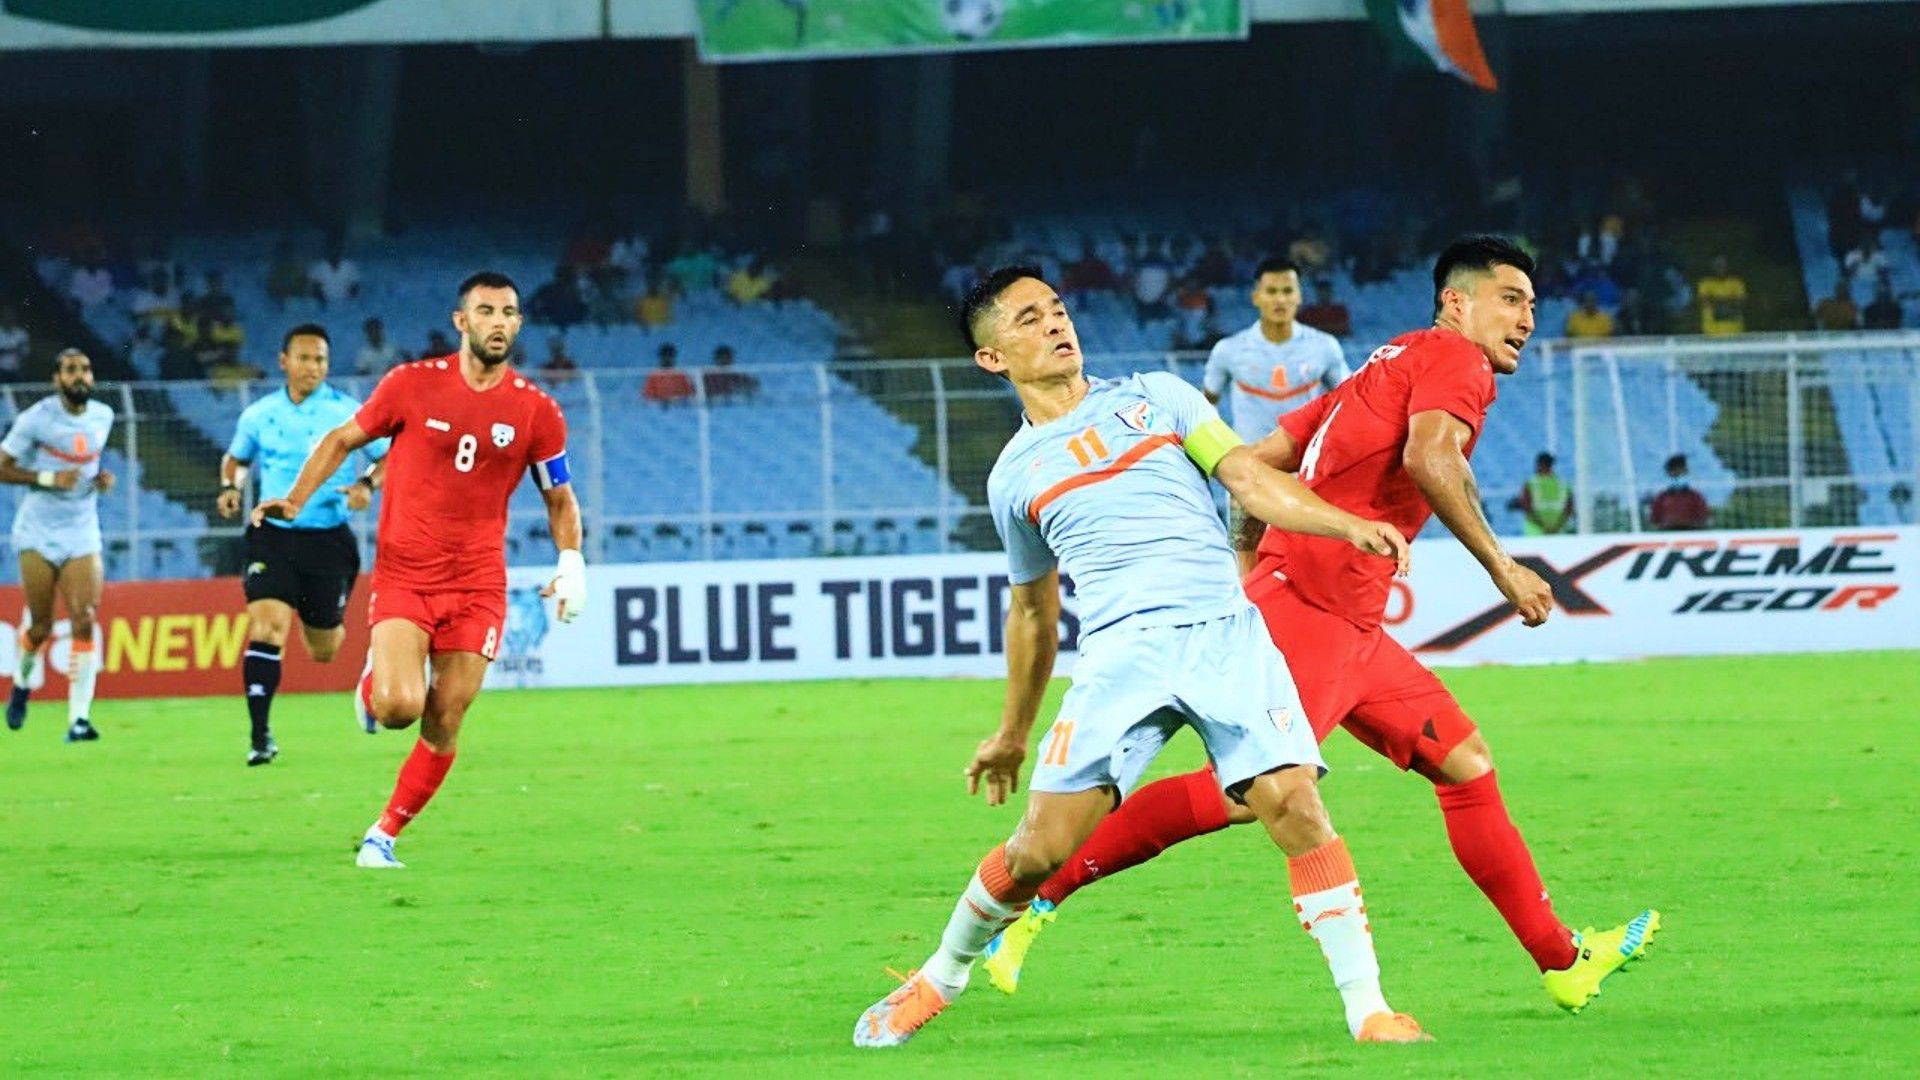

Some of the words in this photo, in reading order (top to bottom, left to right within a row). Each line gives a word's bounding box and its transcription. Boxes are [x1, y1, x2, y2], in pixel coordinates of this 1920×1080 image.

[455, 434, 478, 473] 8
[1066, 426, 1109, 468] 11
[1673, 584, 1900, 615] 160R
[106, 612, 249, 673] NEW
[614, 582, 797, 666] BLUE
[1044, 719, 1075, 767] 11
